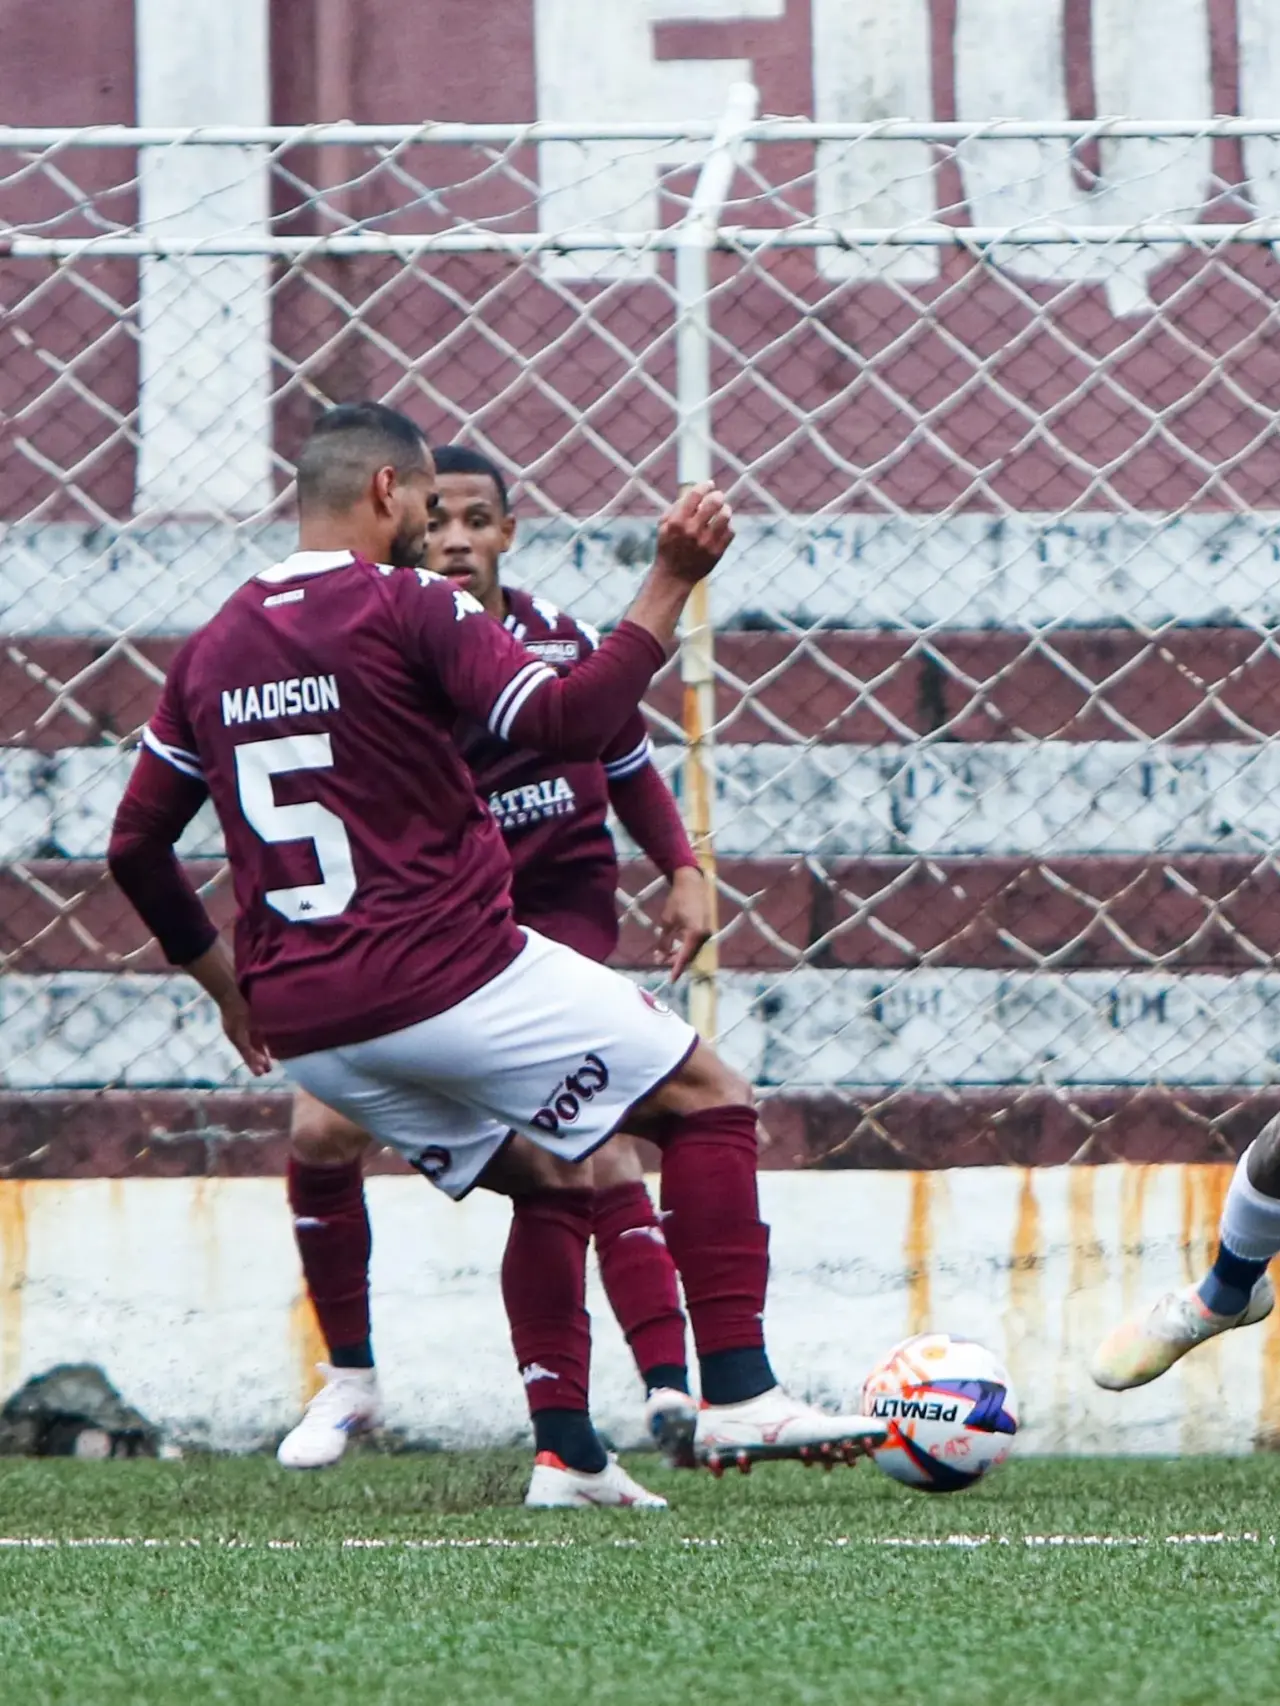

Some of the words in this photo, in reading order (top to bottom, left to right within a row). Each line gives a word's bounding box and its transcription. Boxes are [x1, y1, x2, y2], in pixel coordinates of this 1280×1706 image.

[221, 674, 341, 727] MADISON
[489, 775, 576, 816] ÁTRIA
[233, 732, 358, 922] 5
[870, 1398, 959, 1423] PENALTY
